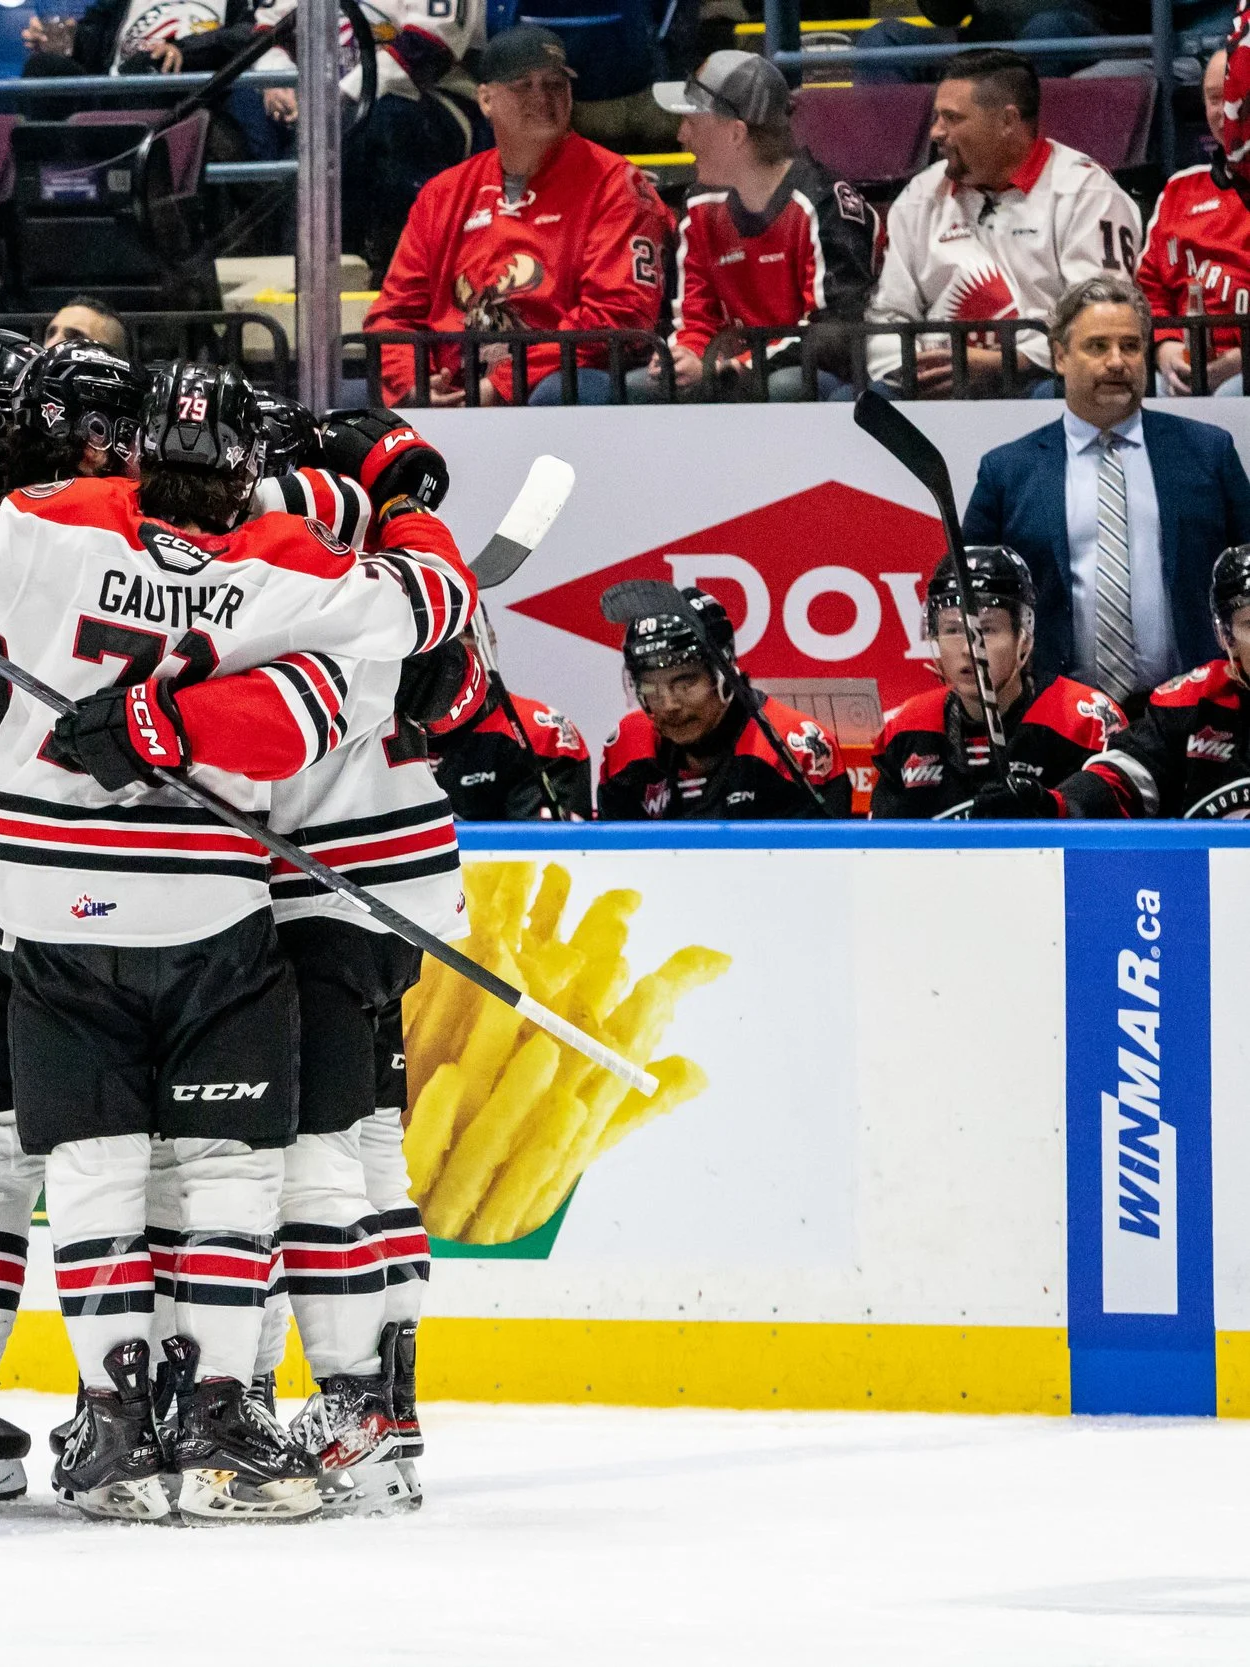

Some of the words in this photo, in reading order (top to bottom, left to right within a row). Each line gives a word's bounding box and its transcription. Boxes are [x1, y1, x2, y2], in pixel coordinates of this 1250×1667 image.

[178, 396, 208, 422] 79
[153, 532, 212, 562] CCM
[637, 617, 657, 635] 20
[130, 683, 168, 756] CCM
[901, 764, 944, 785] WHL
[83, 902, 109, 917] CHL
[172, 1081, 270, 1101] CCM
